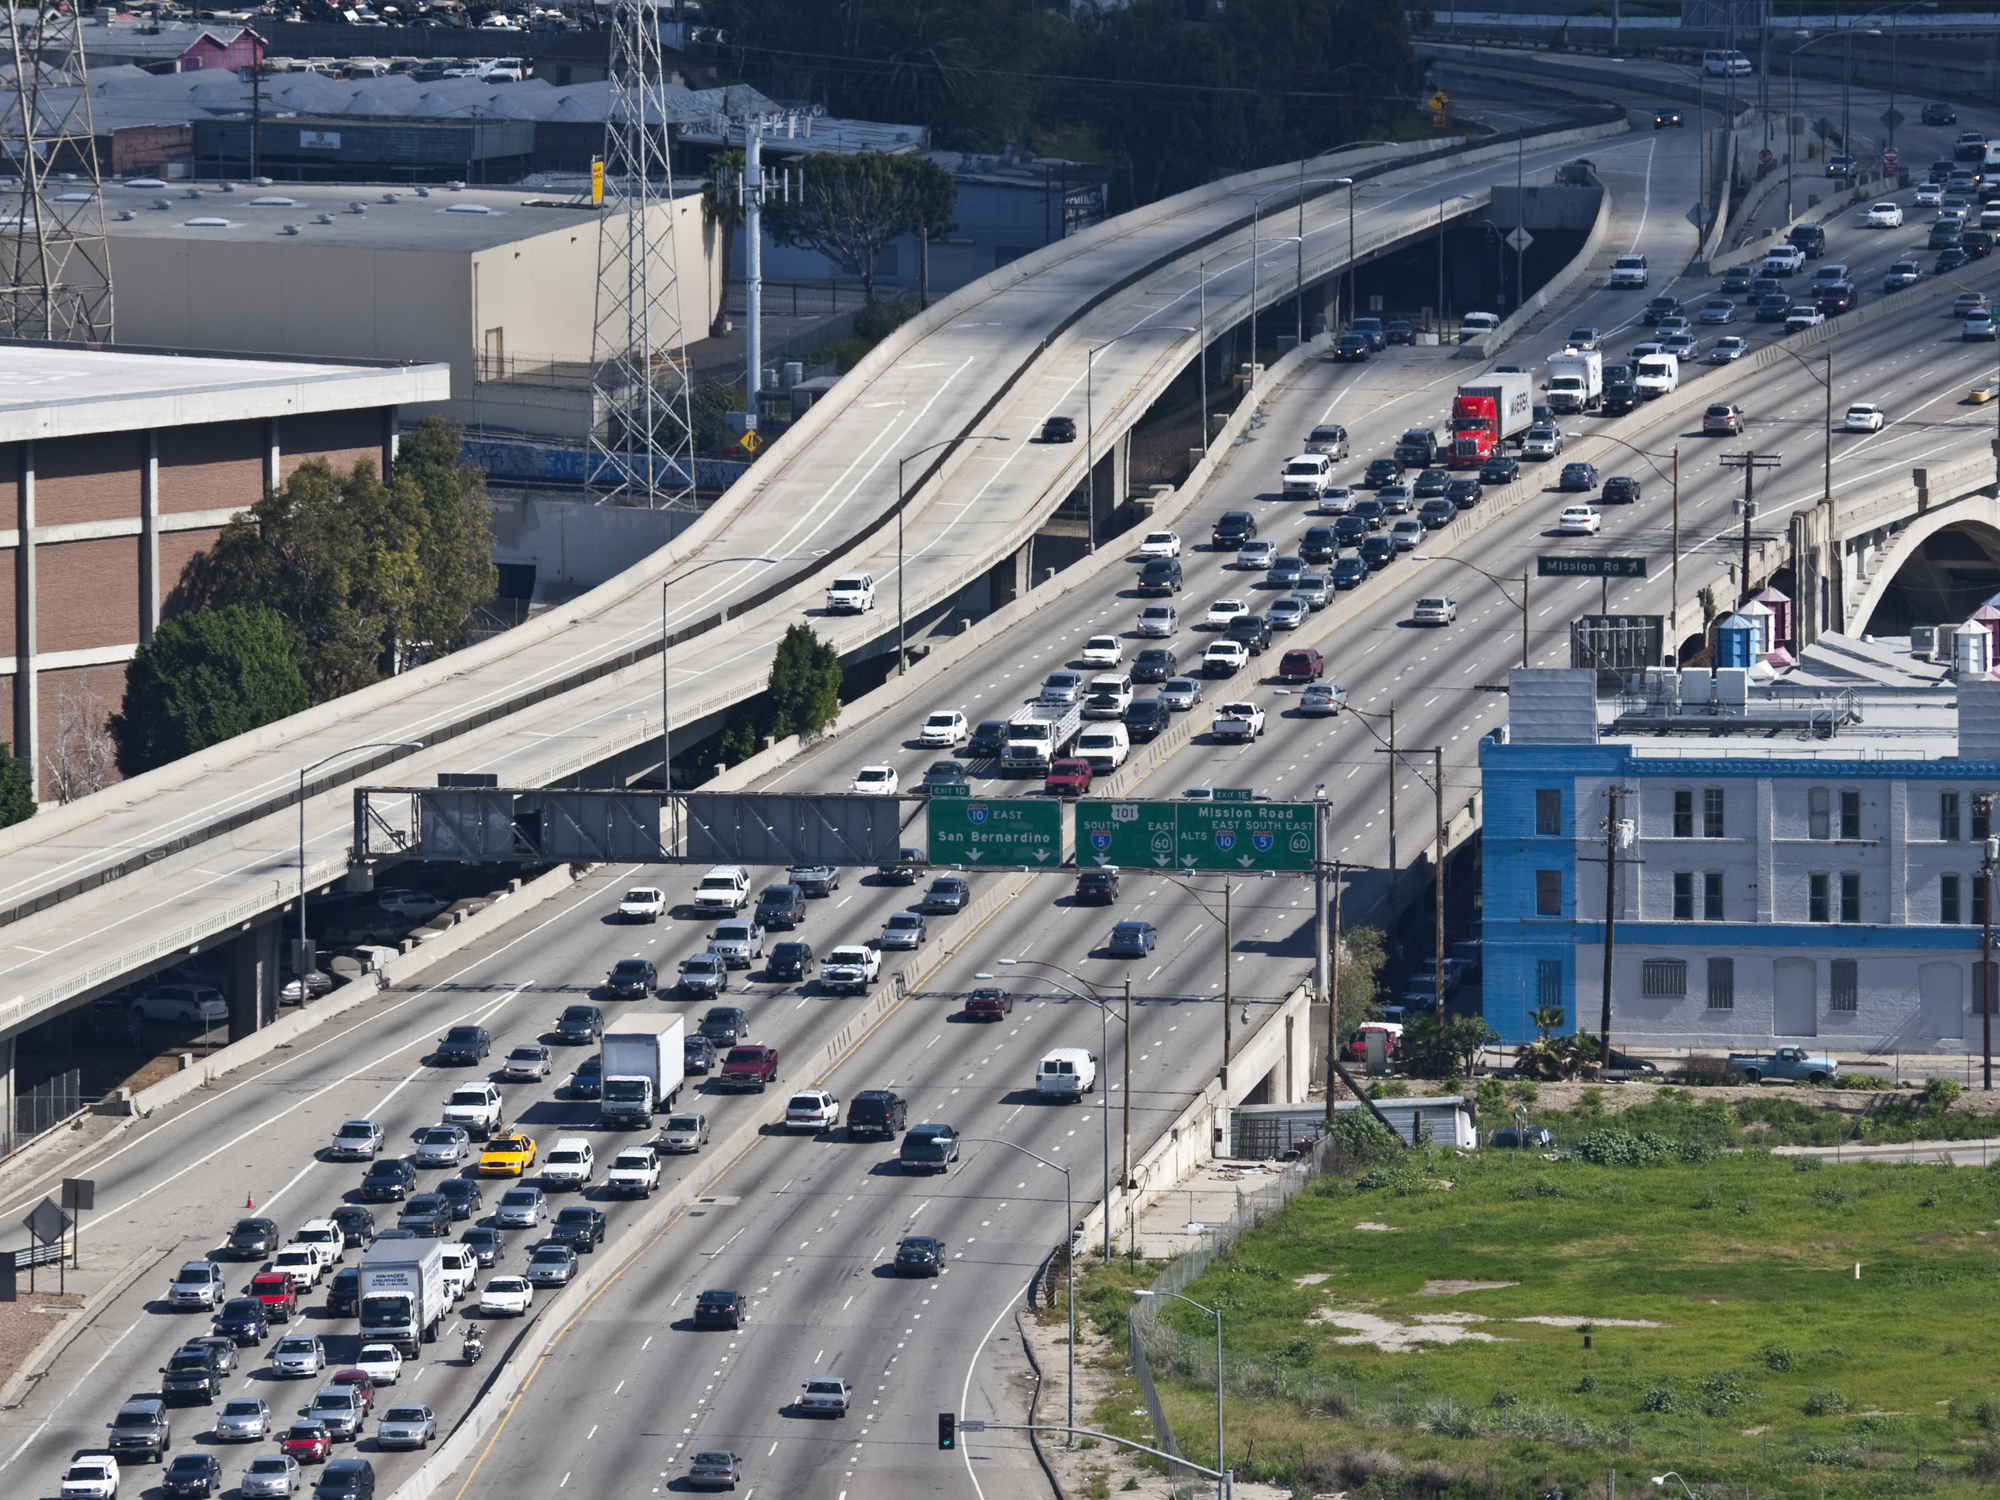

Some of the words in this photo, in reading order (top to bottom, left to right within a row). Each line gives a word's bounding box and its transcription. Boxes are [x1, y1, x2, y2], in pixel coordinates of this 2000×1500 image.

[1547, 561, 1595, 571] Mission
[1604, 562, 1619, 571] Rd
[1238, 791, 1248, 799] 1E
[972, 811, 984, 821] 10
[993, 811, 1023, 820] EAST
[1116, 808, 1134, 818] 101
[1198, 807, 1252, 818] Mission
[1259, 808, 1294, 819] Road
[1084, 821, 1120, 830] SOUTH
[1148, 822, 1176, 831] EAST
[1212, 821, 1240, 829] EAST
[1246, 821, 1281, 830] SOUTH
[1285, 822, 1313, 830] EAST
[938, 831, 964, 842] San
[971, 831, 1050, 843] Bernardino
[1180, 832, 1207, 840] ALTS
[1098, 837, 1105, 847] 5
[1154, 838, 1169, 849] 60
[1220, 837, 1231, 847] 10
[1260, 837, 1267, 847] 5
[1293, 839, 1307, 849] 60
